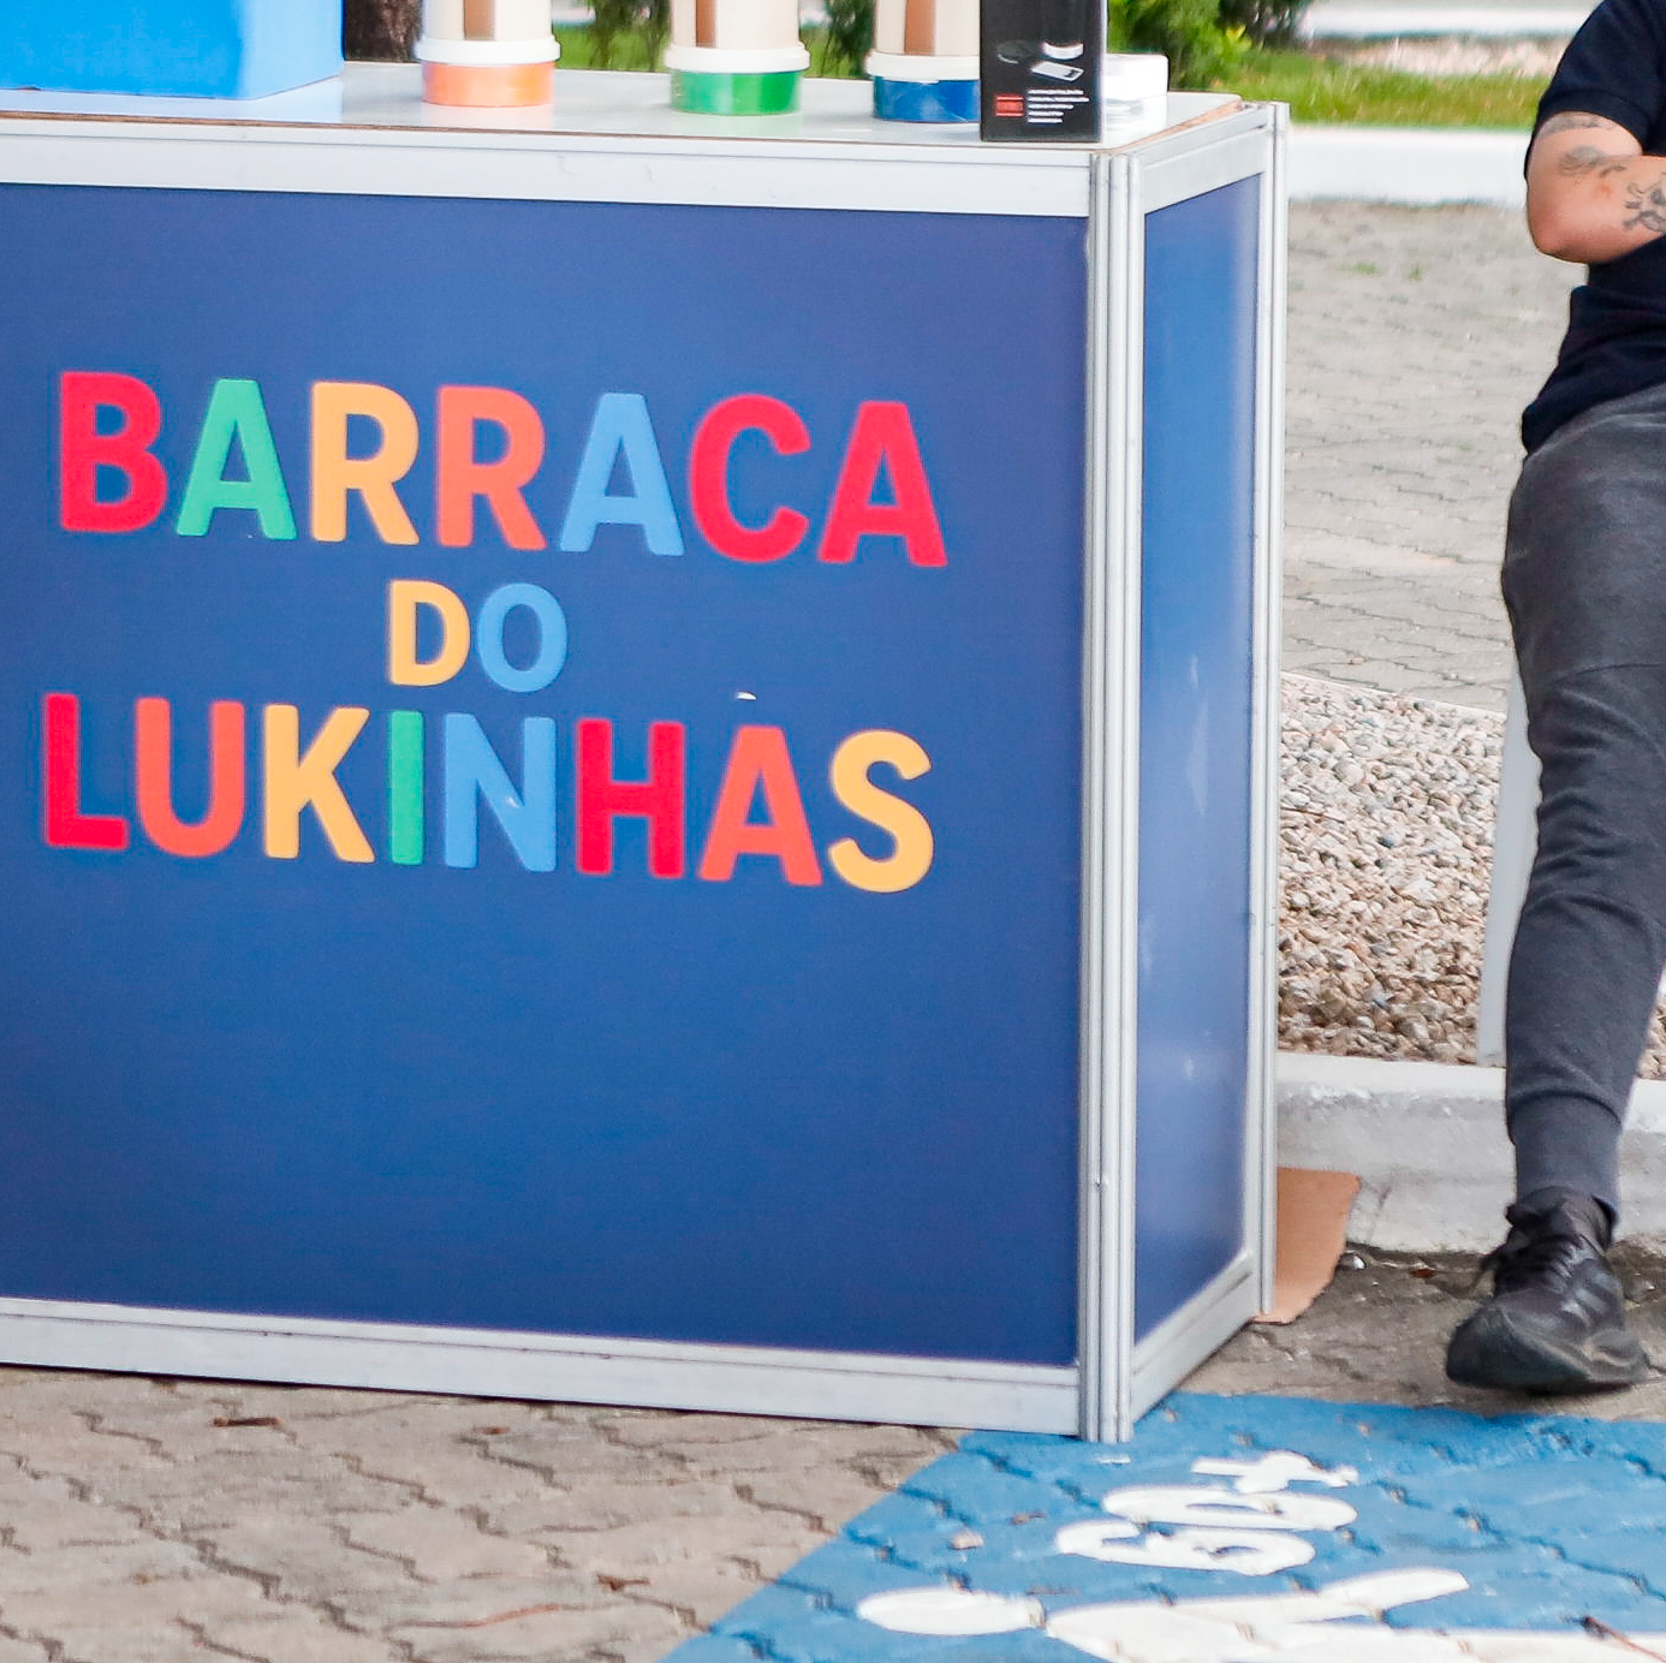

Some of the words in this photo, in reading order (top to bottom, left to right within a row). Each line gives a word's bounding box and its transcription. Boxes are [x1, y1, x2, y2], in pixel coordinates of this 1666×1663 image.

[56, 370, 949, 568] BARRACA
[387, 578, 569, 693] DO
[42, 691, 935, 894] LUKINHAS
